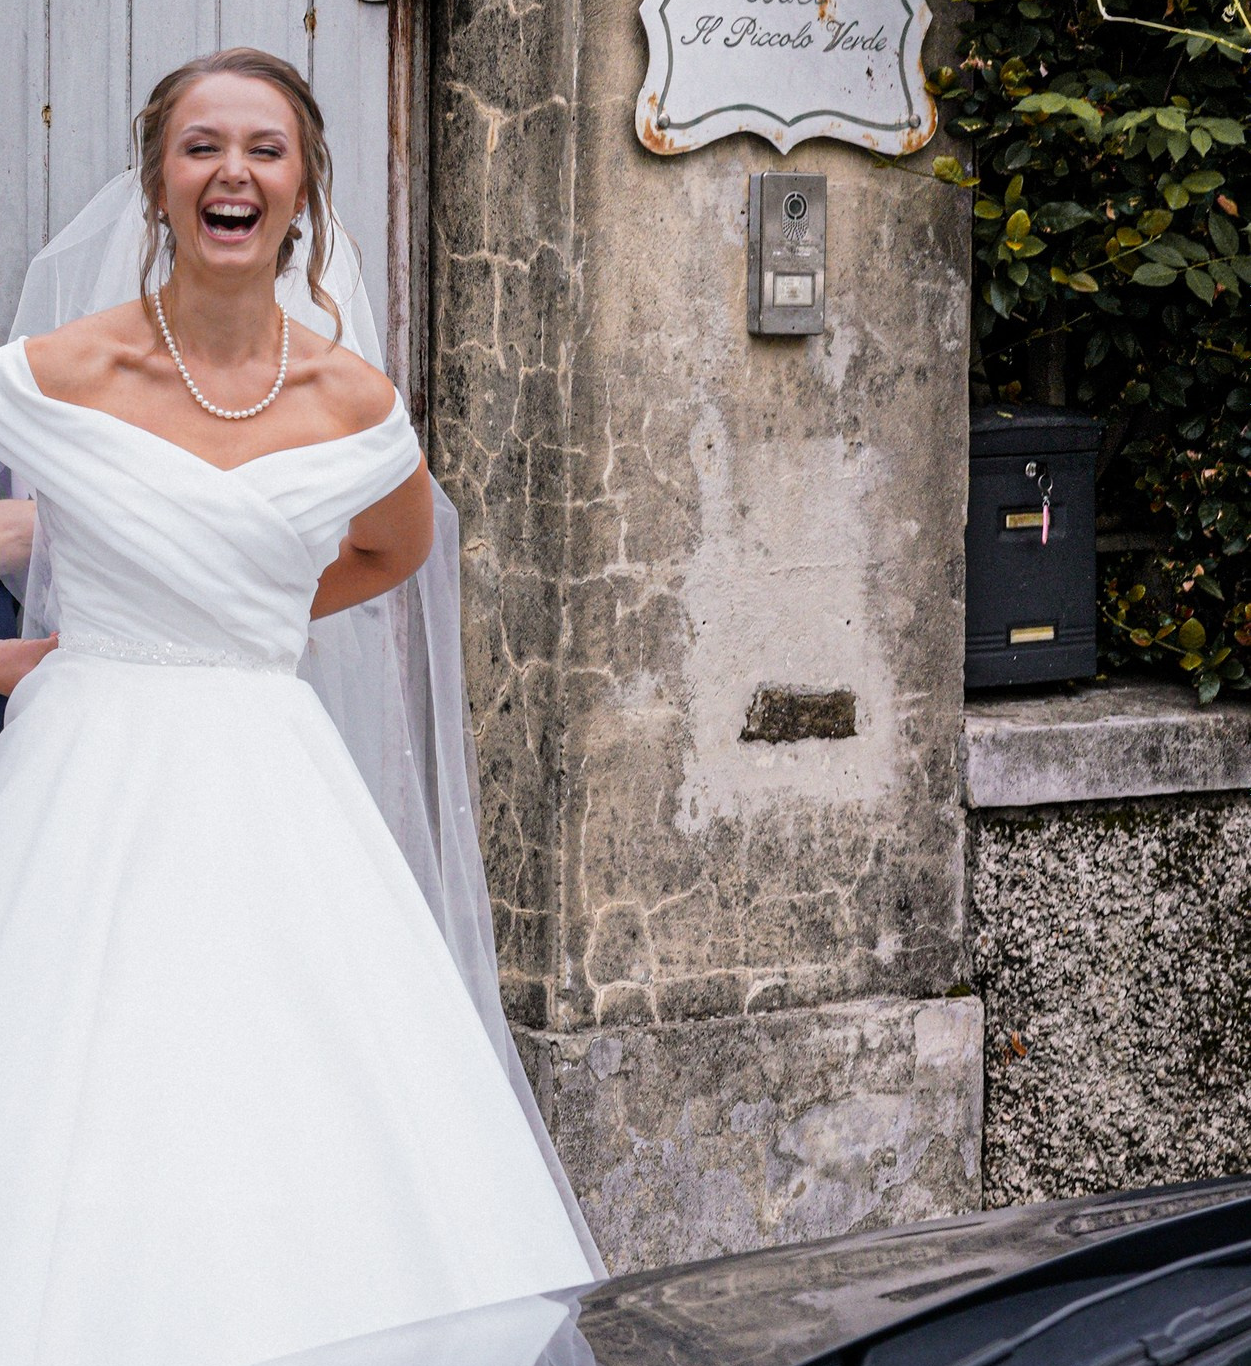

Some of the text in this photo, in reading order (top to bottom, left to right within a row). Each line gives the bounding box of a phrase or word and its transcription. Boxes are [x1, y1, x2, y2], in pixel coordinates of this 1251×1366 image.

[680, 15, 888, 53] Il Piccolo Verde
